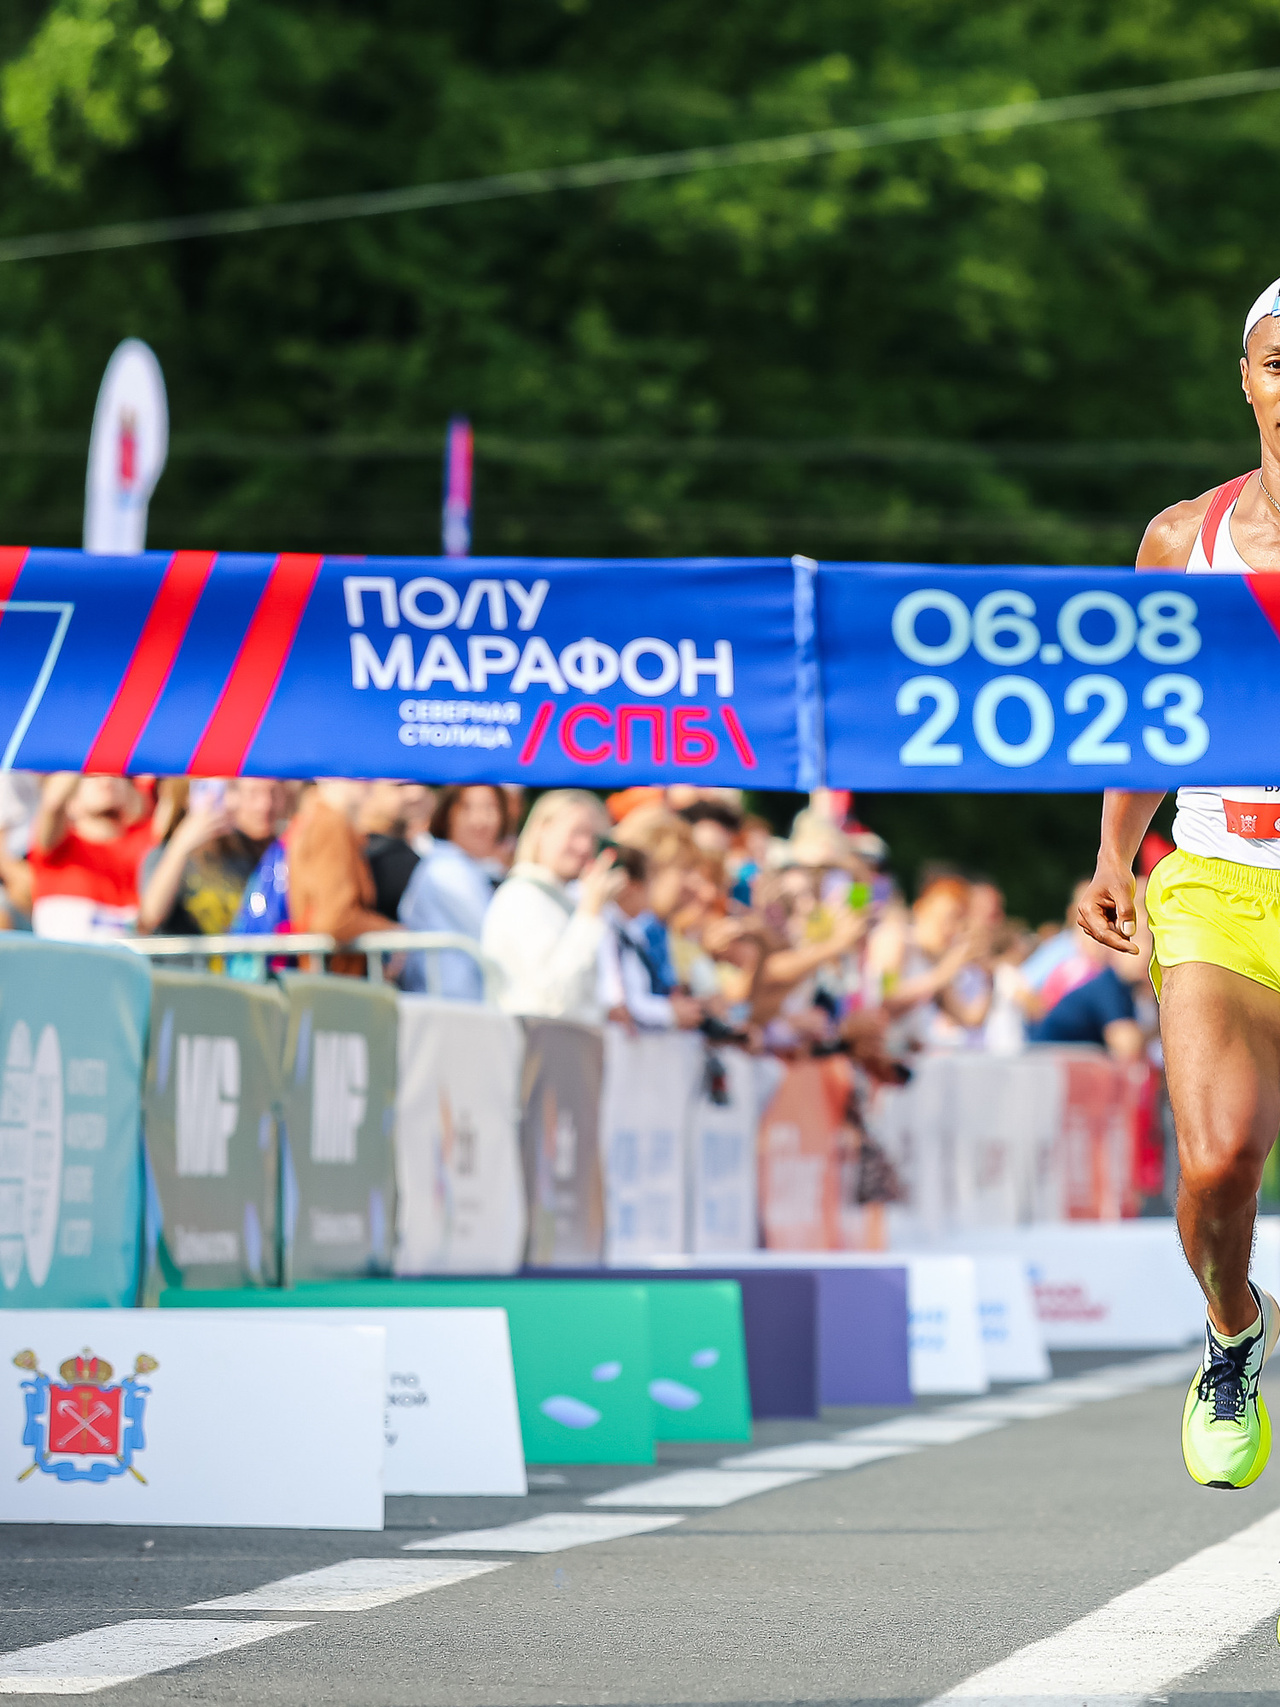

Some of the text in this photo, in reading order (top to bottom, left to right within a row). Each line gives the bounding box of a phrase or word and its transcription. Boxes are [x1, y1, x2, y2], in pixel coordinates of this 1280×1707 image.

[343, 576, 550, 631] ПОЛУ
[892, 588, 1201, 666] 06.08
[350, 634, 735, 698] МАРАФОН
[398, 723, 513, 750] СТОЛИЦА
[399, 699, 521, 725] СЕВЕРНАЯ
[895, 673, 1211, 767] 2023
